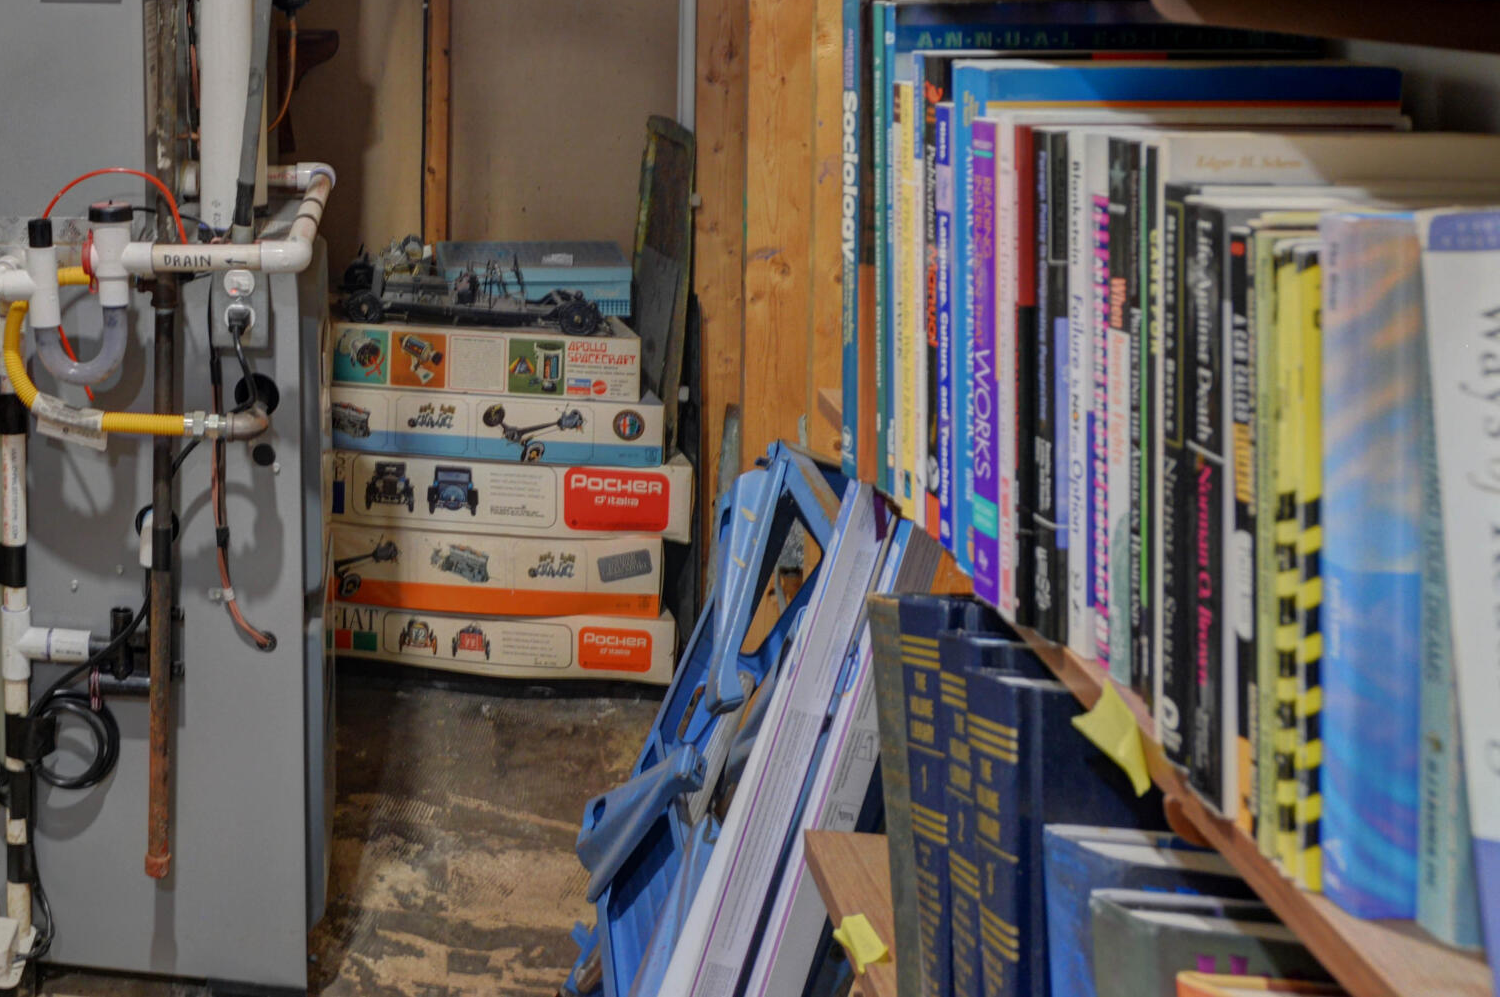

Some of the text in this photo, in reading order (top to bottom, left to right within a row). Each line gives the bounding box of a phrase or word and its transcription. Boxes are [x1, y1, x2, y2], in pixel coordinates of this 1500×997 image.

[842, 90, 859, 264] Sociology
[1072, 160, 1082, 265] Blankstein
[926, 144, 939, 348] Publication Manual
[983, 176, 992, 258] READING
[163, 254, 212, 268] DRAIN
[1072, 295, 1084, 370] Failure
[1110, 277, 1127, 328] When
[1193, 219, 1213, 442] Life Against Death
[567, 340, 607, 353] APOLLO
[567, 352, 637, 365] SPACECRAFT
[940, 385, 950, 421] and
[974, 349, 991, 480] WORKS
[571, 473, 663, 495] POCHER
[939, 426, 951, 507] Teaching
[1069, 459, 1084, 534] Option
[1197, 463, 1213, 567] Norman
[1163, 455, 1177, 684] NICHOLAS SPARKS
[336, 606, 378, 632] IAT
[583, 632, 647, 648] POCHER
[1197, 605, 1213, 686] Brown
